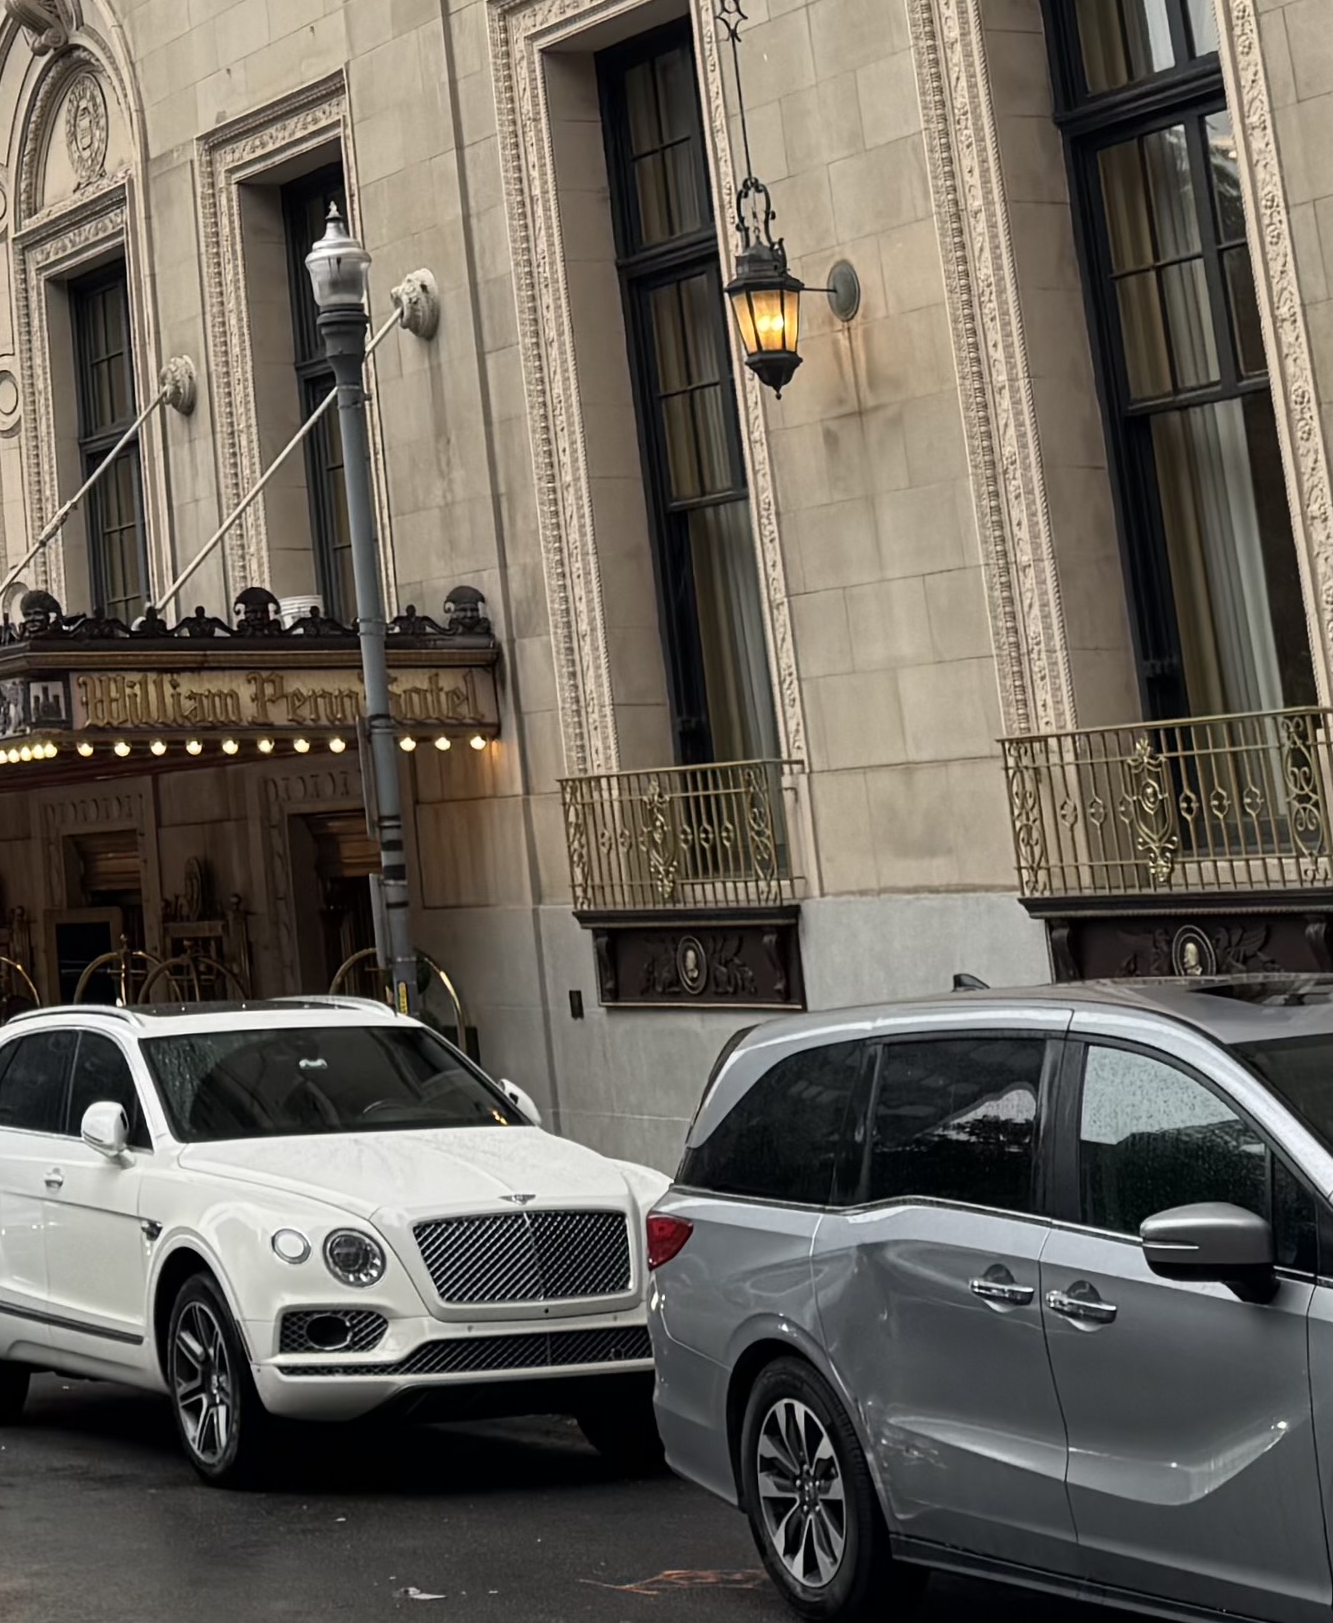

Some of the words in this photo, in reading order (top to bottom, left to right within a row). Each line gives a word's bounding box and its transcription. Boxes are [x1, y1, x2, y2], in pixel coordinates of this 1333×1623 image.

[78, 673, 241, 728] William
[246, 670, 359, 724] Penn
[371, 668, 487, 723] otel
